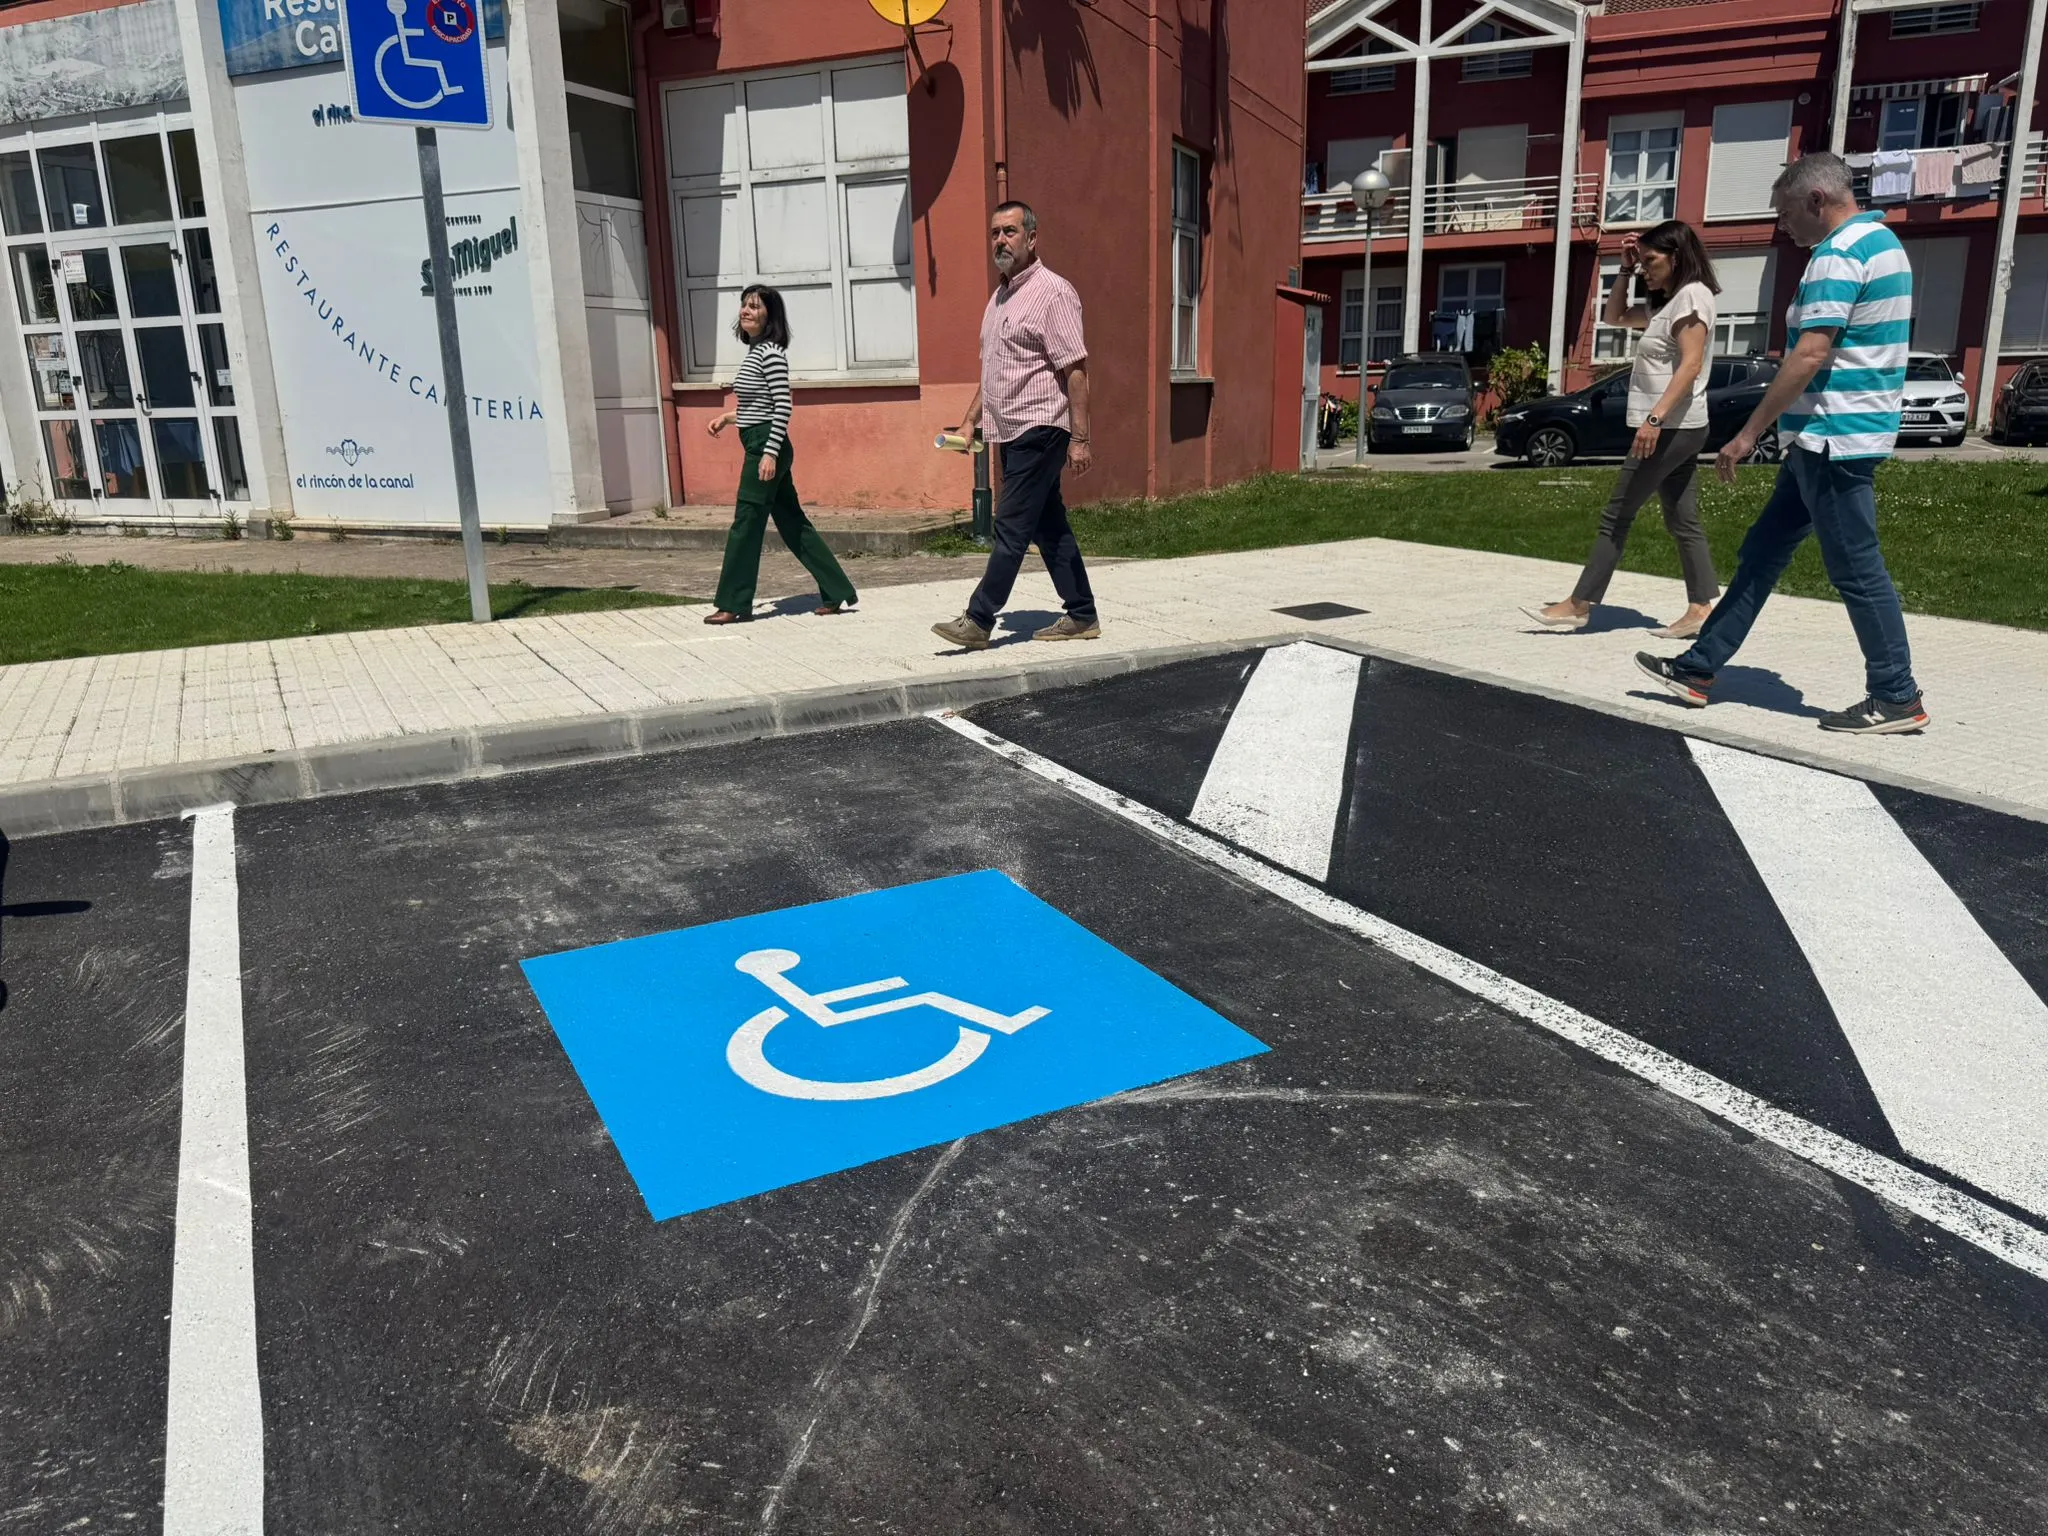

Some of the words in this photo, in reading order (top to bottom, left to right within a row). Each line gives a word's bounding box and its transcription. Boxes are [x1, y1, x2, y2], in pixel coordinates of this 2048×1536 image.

[446, 13, 455, 23] P
[295, 20, 341, 56] Ca
[431, 25, 472, 43] DISCAPACIDAD
[312, 103, 325, 127] el
[266, 222, 401, 383] RESTAURANTE
[409, 375, 544, 420] CATERÍA
[296, 473, 307, 488] el
[309, 473, 346, 489] rincón
[347, 473, 363, 488] de
[364, 473, 378, 489] la
[379, 473, 414, 489] canal
